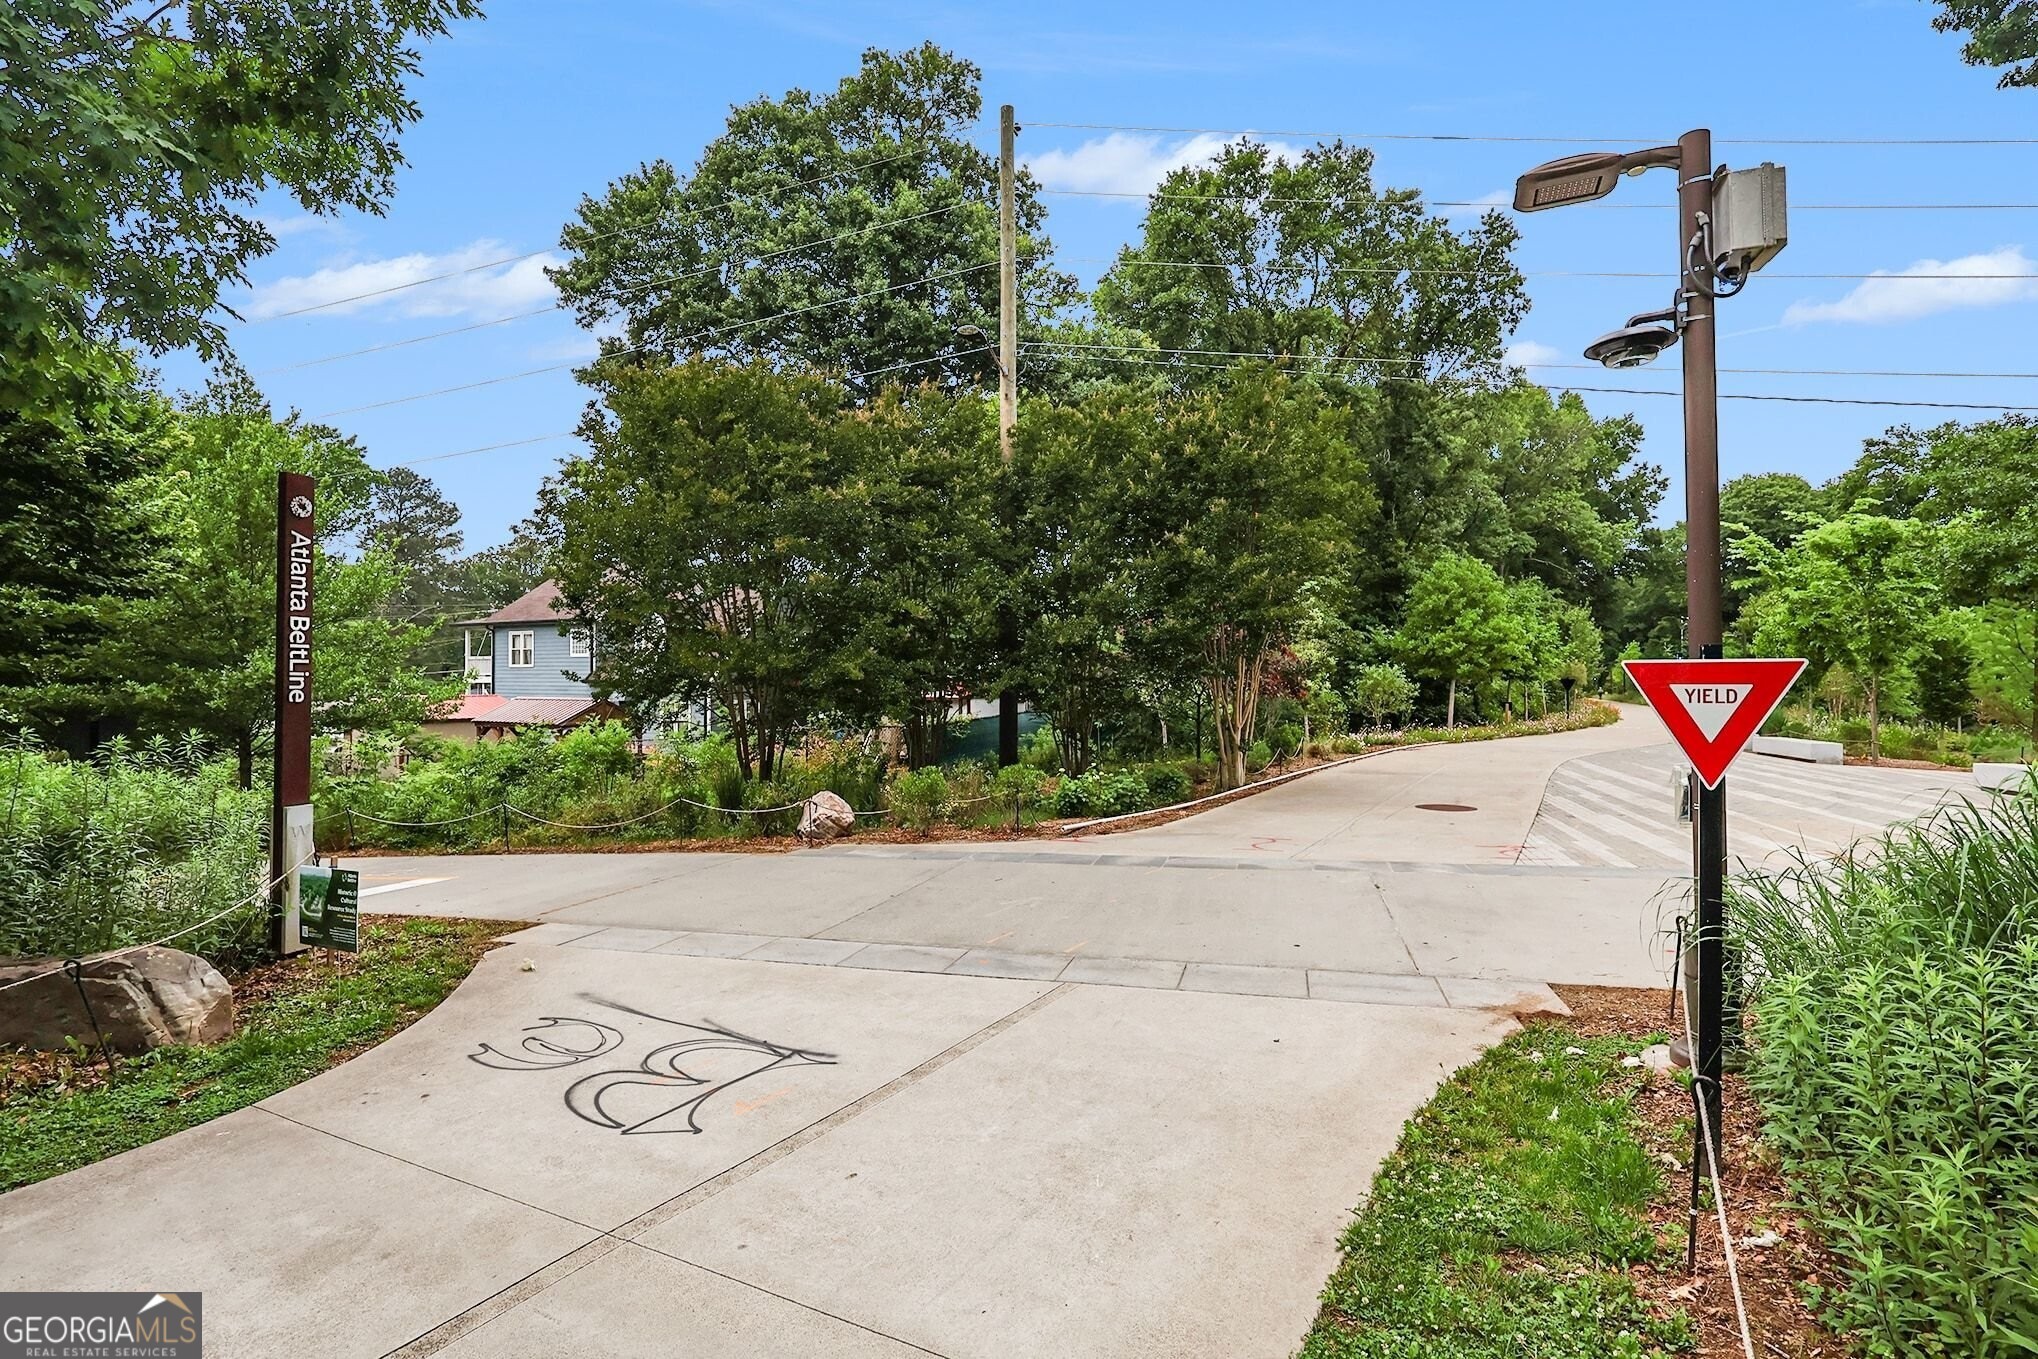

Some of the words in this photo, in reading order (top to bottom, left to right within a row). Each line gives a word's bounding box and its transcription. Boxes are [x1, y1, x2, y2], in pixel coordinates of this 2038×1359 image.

[290, 529, 312, 612] Atlanta
[288, 616, 311, 703] BeltLine
[1684, 688, 1738, 704] YIELD
